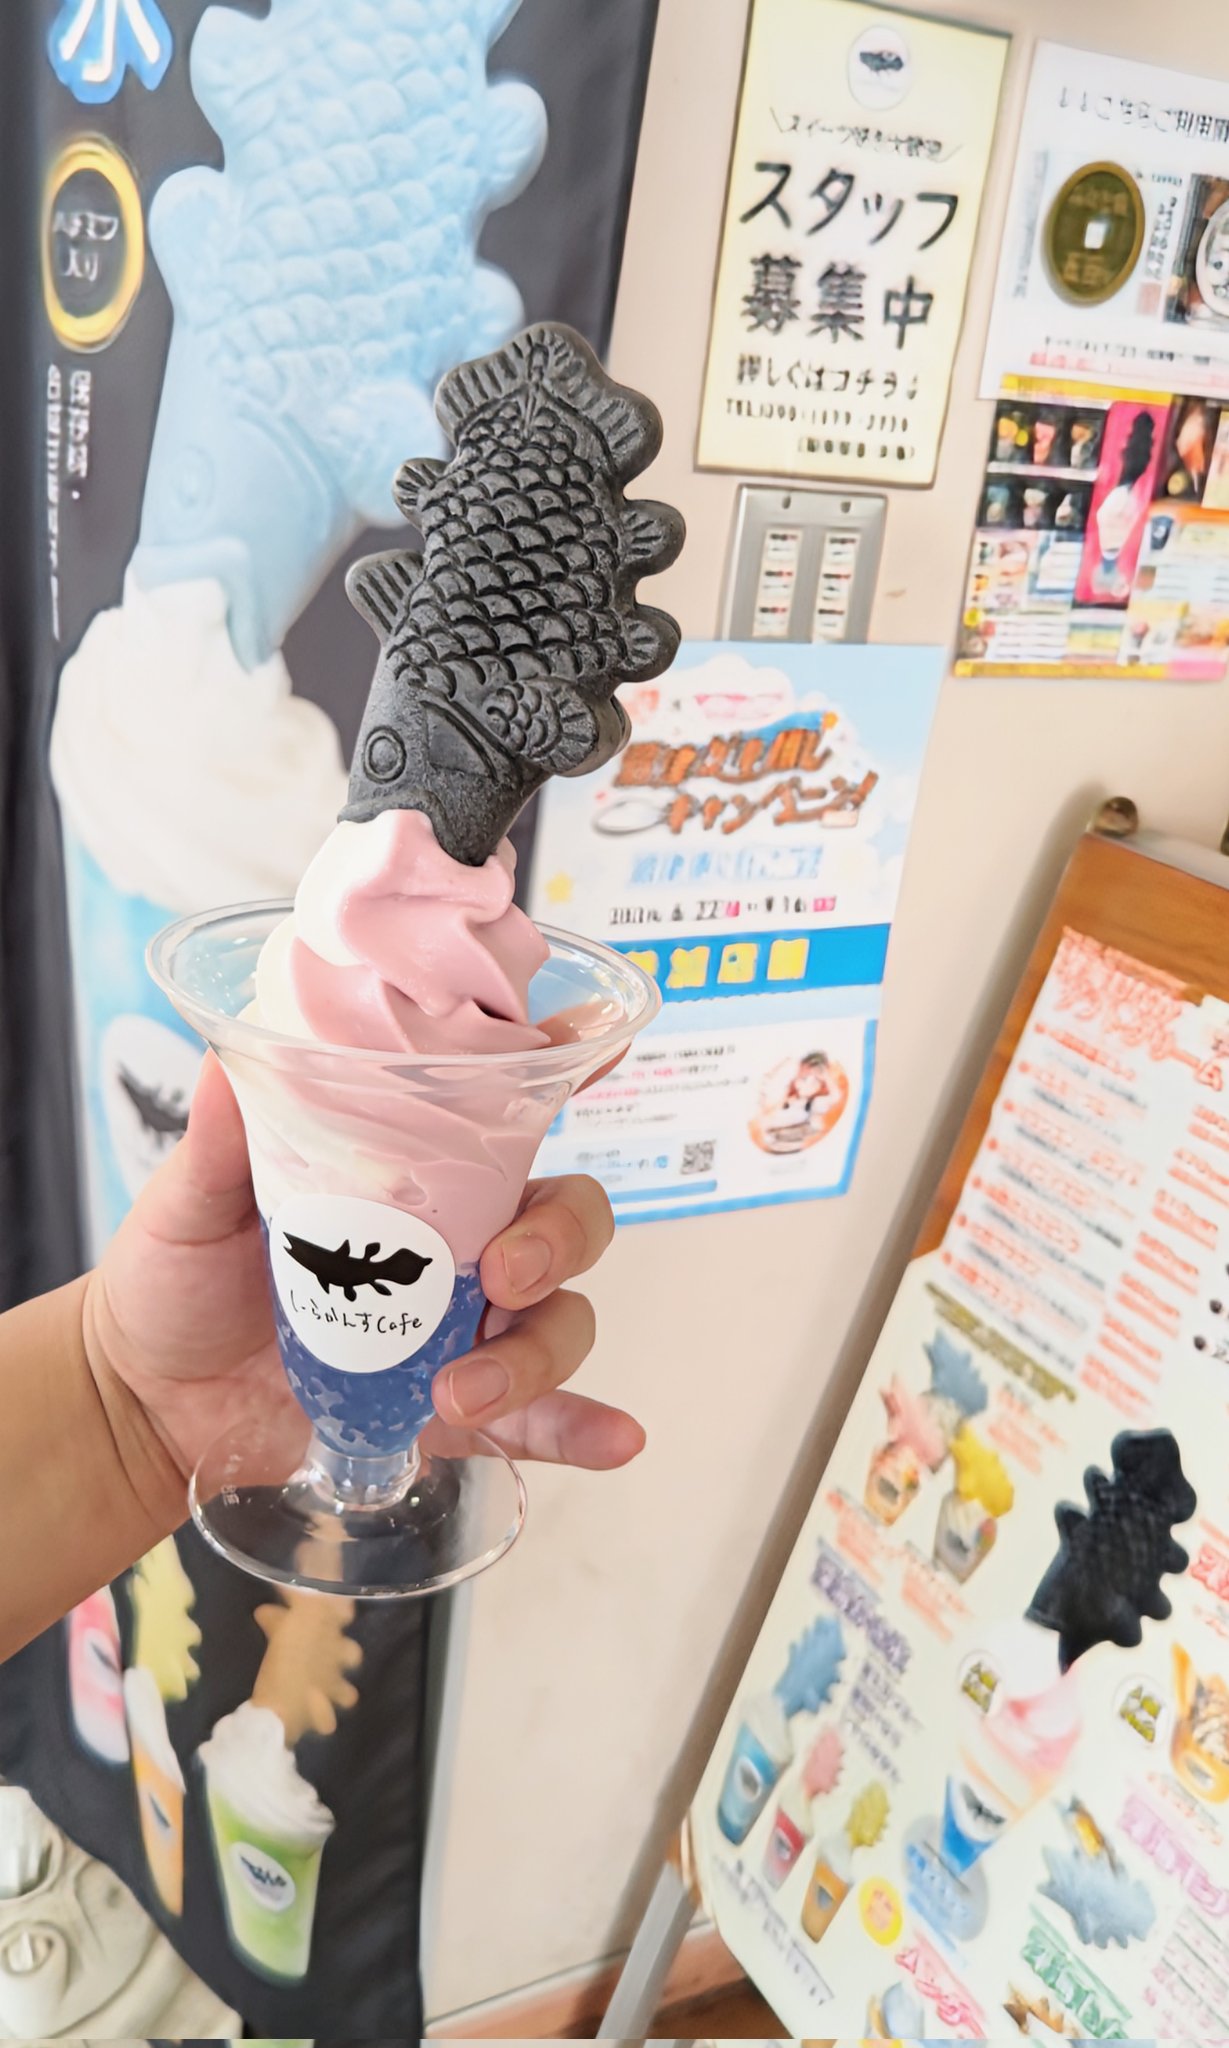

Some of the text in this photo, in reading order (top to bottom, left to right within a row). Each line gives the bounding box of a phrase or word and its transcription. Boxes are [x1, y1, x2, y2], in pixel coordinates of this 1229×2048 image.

[738, 160, 959, 250] スタッフ
[740, 252, 936, 350] 募集中
